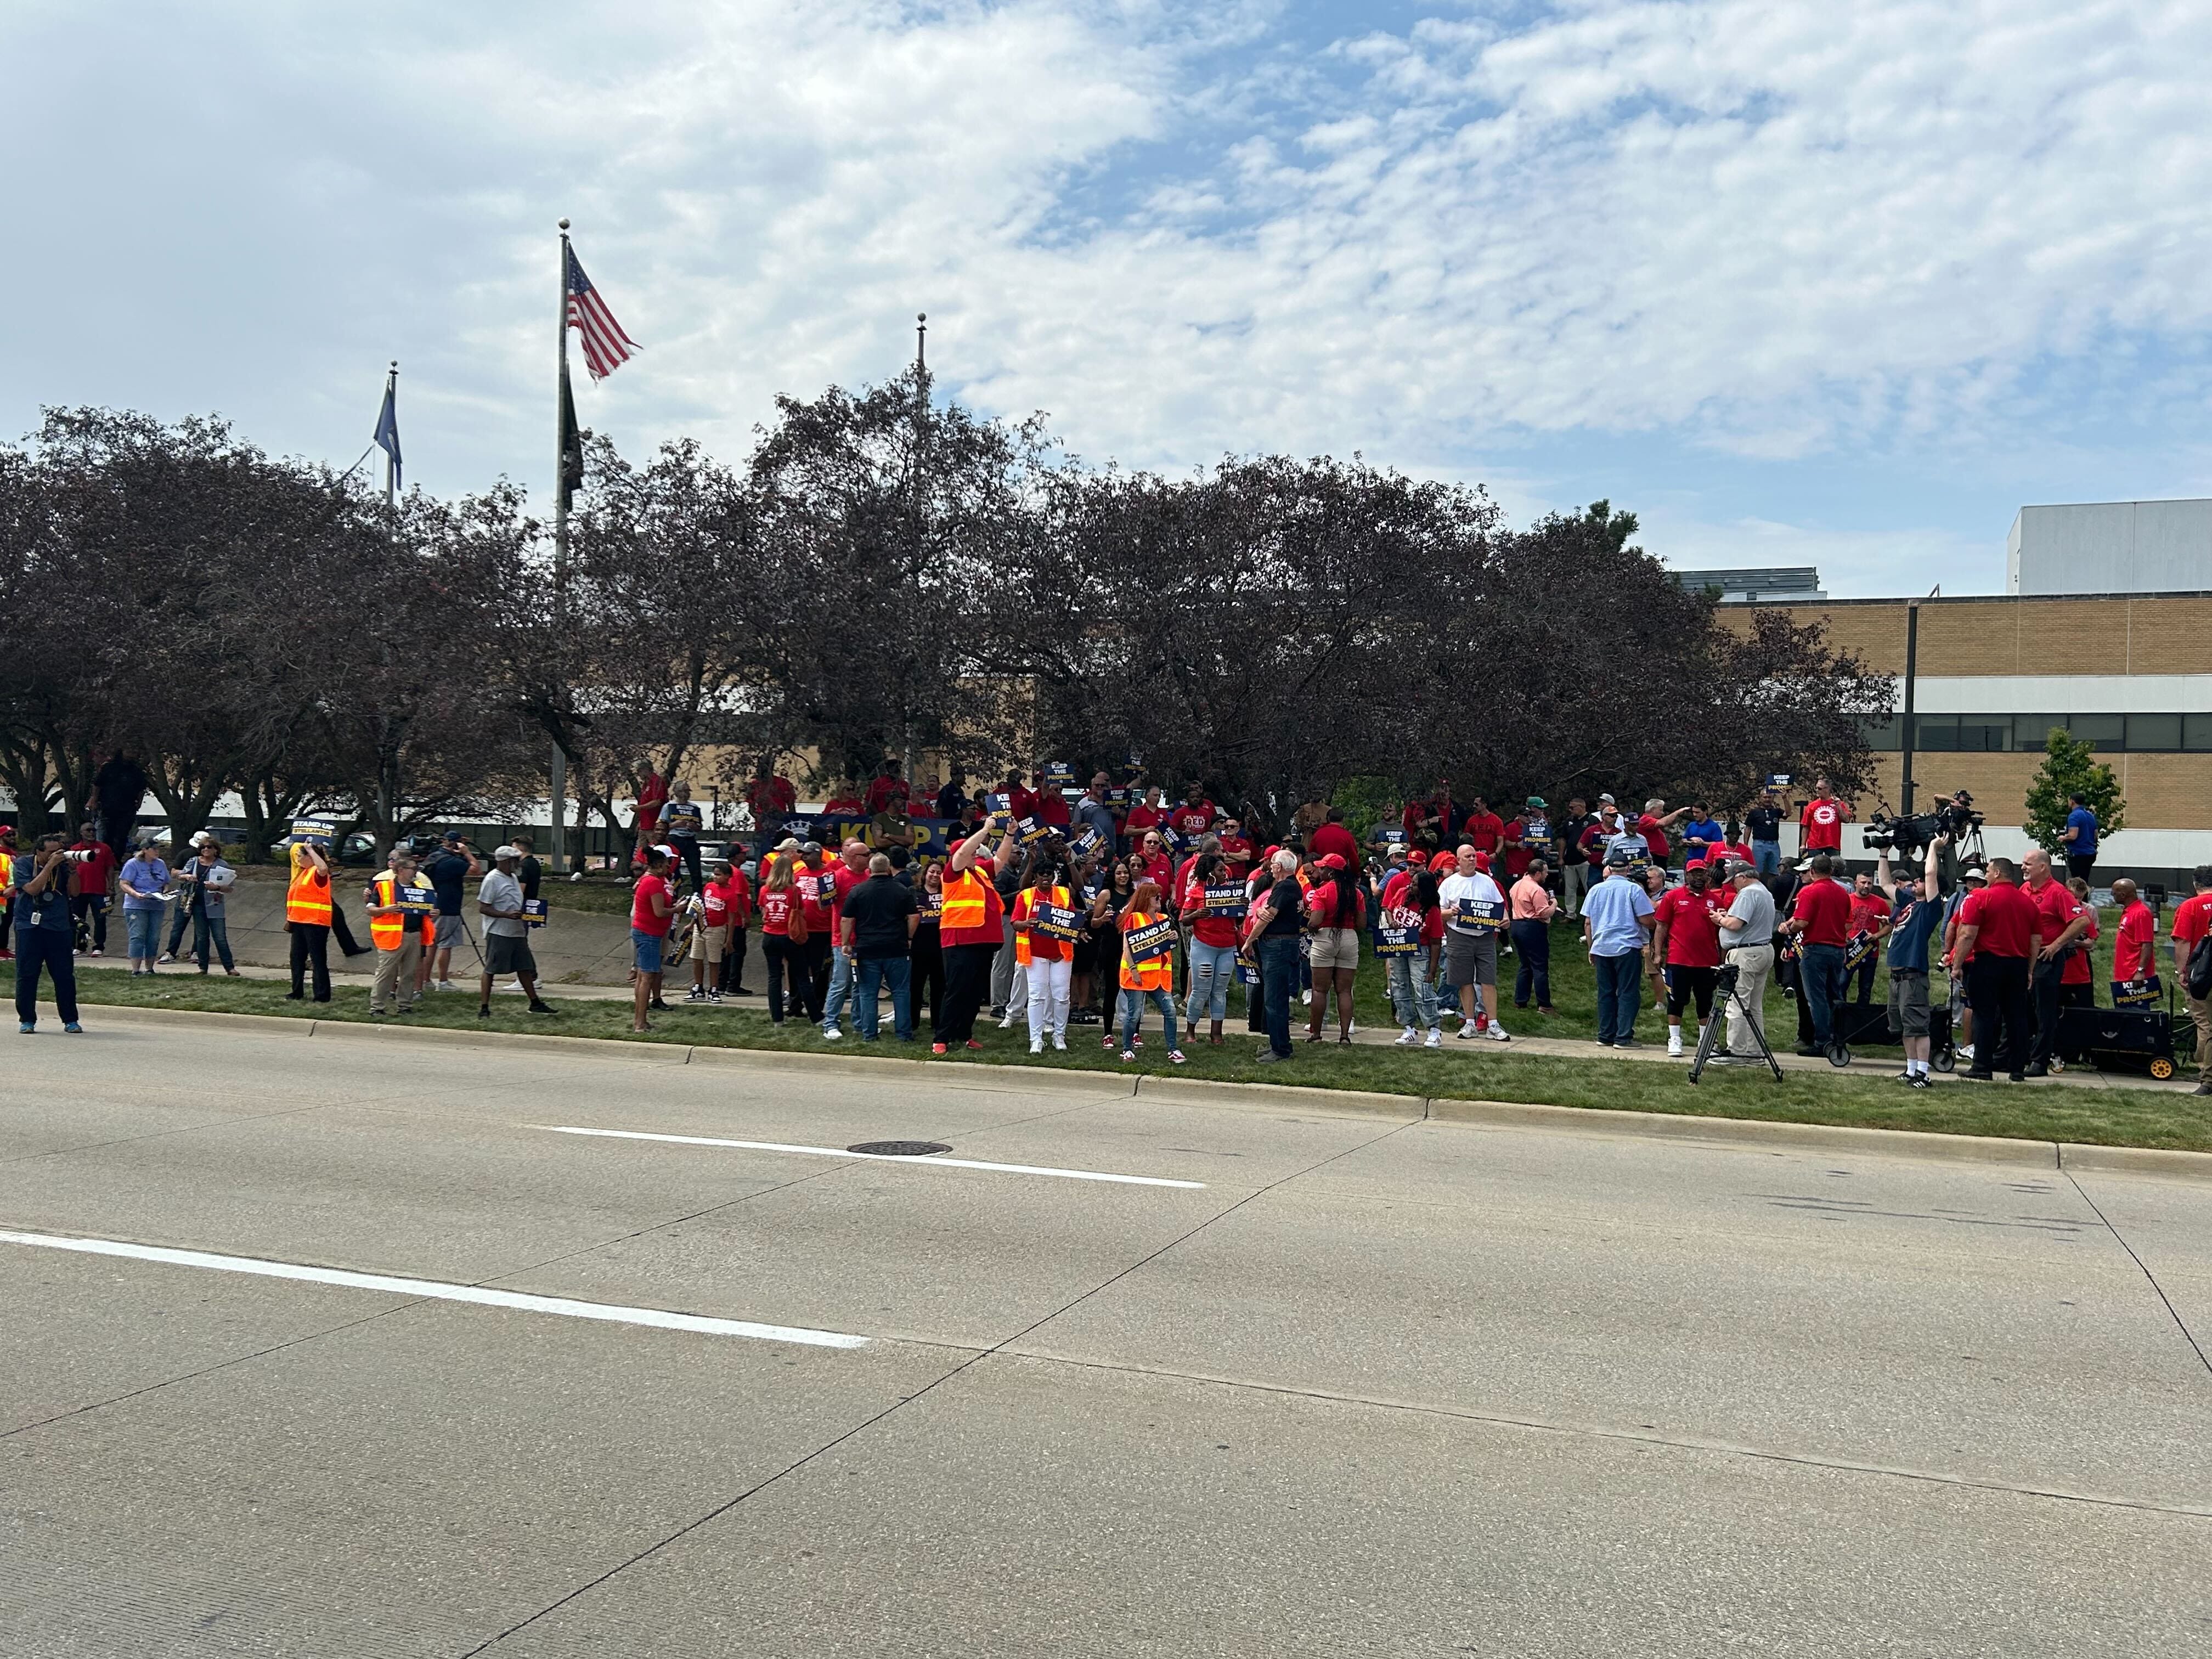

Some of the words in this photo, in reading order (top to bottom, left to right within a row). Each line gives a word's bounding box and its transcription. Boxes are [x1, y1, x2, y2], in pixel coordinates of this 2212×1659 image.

[1018, 817, 1034, 828] KEEP
[1023, 824, 1036, 834] THE
[840, 823, 931, 849] KEP
[1079, 829, 1094, 847] KEEP
[1164, 831, 1173, 844] THE
[1166, 827, 1180, 842] KEEP
[1085, 836, 1097, 850] THE
[1205, 889, 1231, 898] STAND
[1471, 900, 1494, 910] KEEP
[1050, 907, 1075, 919] KEEP
[1395, 911, 1421, 927] RED
[1472, 909, 1491, 917] THE
[1052, 916, 1071, 927] THE
[1460, 915, 1500, 926] PROMISE
[1038, 922, 1079, 938] PROMISE
[1128, 927, 1159, 944] STAND
[1159, 921, 1170, 932] UP
[1133, 932, 1170, 951] STELLANTI
[1376, 944, 1418, 952] PROMISE
[1846, 943, 1874, 970] PROMISE
[1848, 944, 1864, 958] THE
[2122, 979, 2148, 989] KP
[2117, 990, 2160, 1004] PROMISE
[2126, 987, 2147, 995] THE
